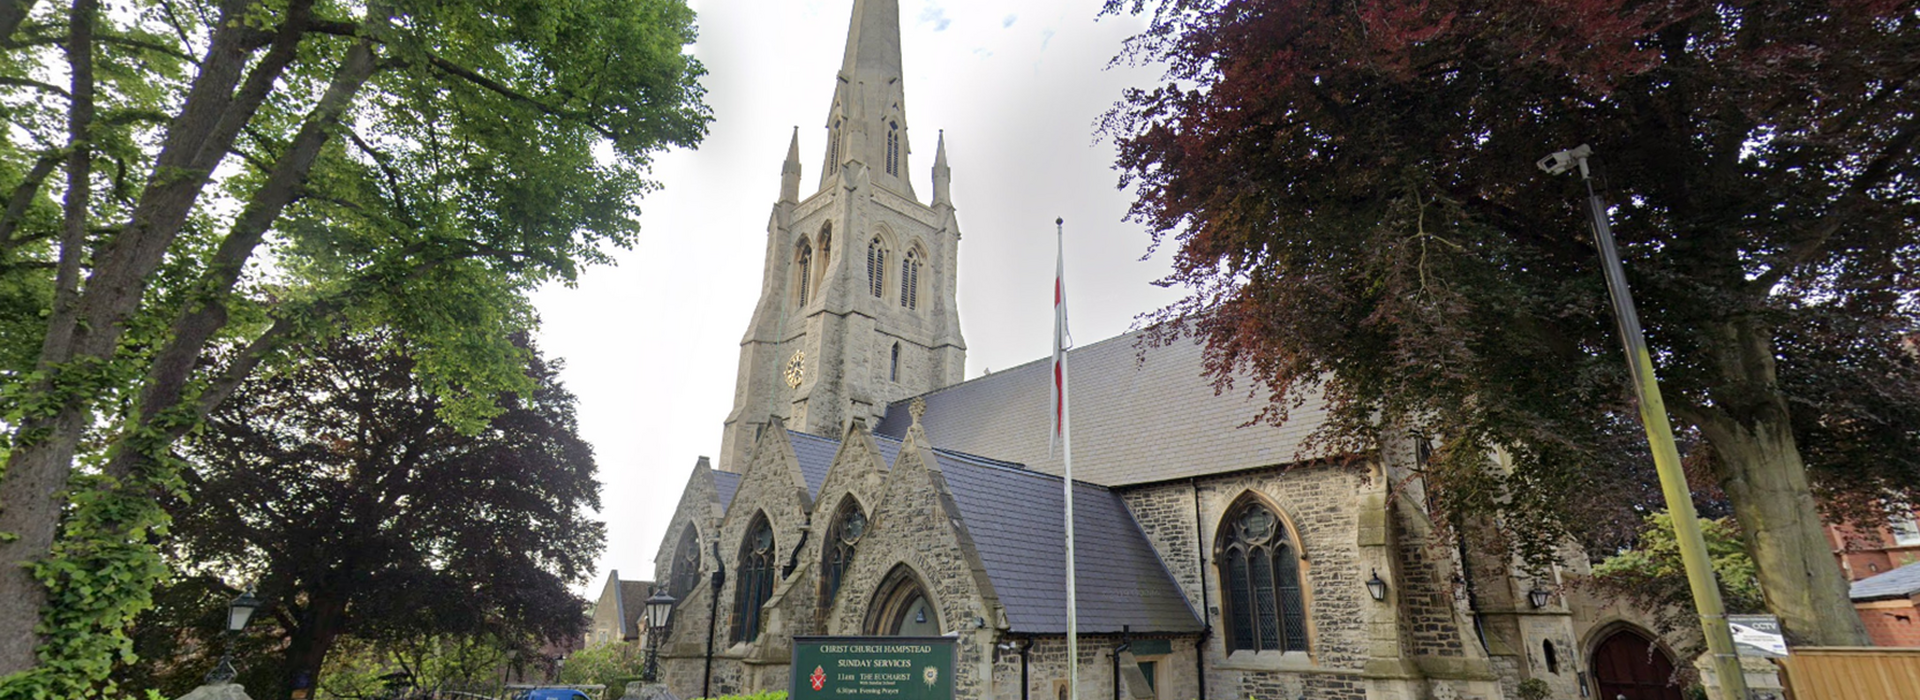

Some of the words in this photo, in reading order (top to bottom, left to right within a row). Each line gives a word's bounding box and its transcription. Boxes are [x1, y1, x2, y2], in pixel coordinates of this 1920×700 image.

[1752, 622, 1777, 630] CCTV
[820, 645, 848, 653] CHRIST
[849, 645, 883, 653] CHURCH
[883, 645, 932, 653] HAMPSTEAD
[837, 659, 873, 667] SUNDAY
[873, 659, 911, 667] SERVICES
[837, 673, 855, 681] 11am
[860, 673, 873, 681] THE
[874, 673, 911, 681] EUCHARIST
[859, 687, 881, 695] Evening
[881, 687, 900, 695] Prayer
